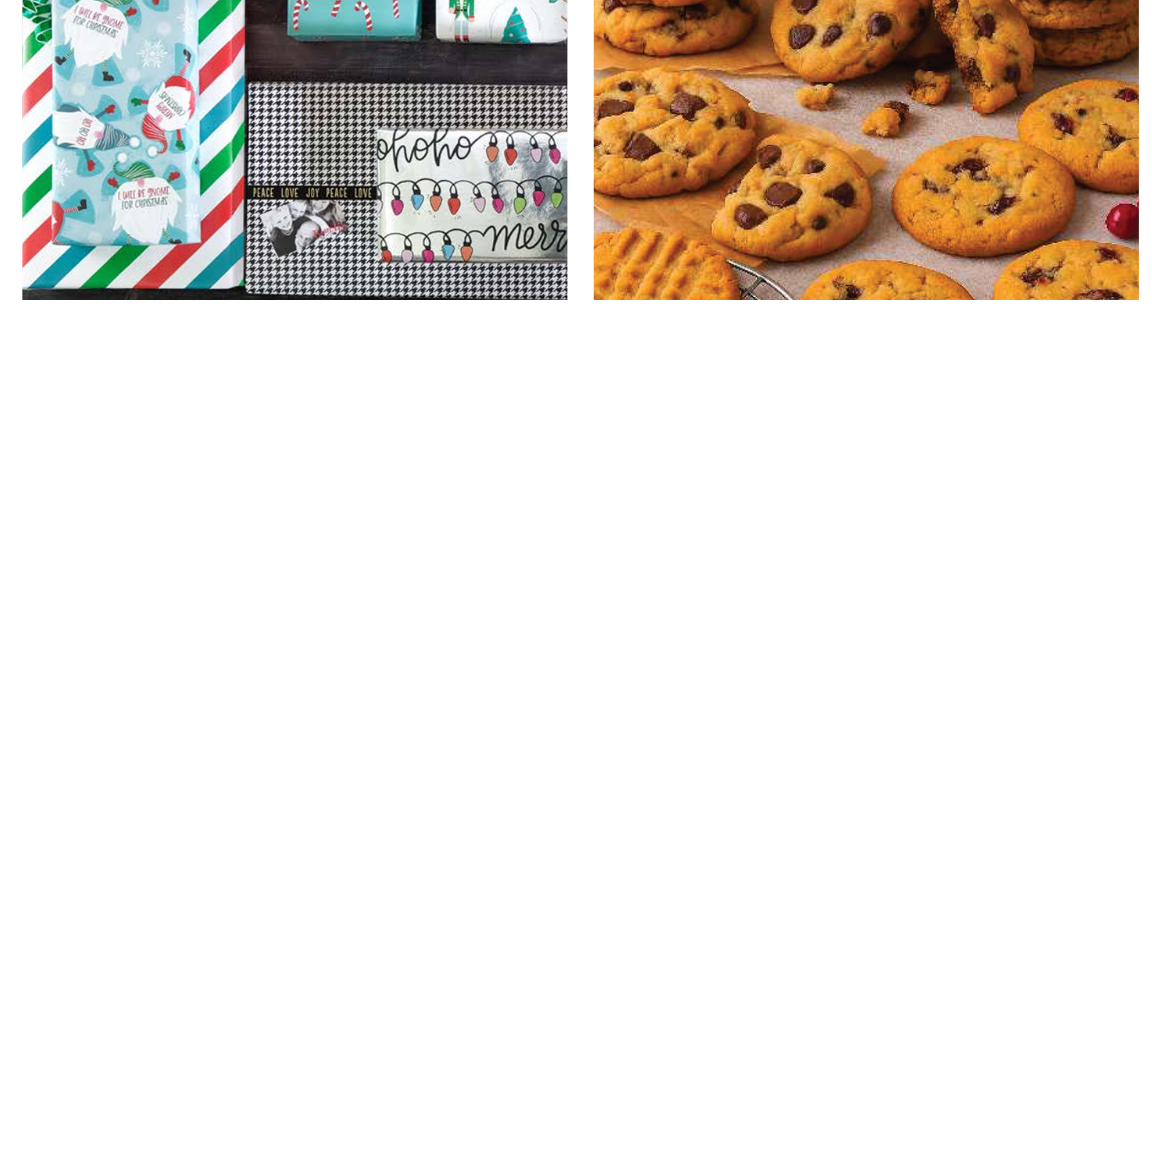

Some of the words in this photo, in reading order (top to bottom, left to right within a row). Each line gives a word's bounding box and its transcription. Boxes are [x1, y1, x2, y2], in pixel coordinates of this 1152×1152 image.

[252, 187, 275, 198] PEACE
[281, 187, 299, 198] LOVE
[305, 187, 319, 198] JOY
[326, 187, 348, 198] PEACE
[354, 187, 372, 198] LOVE
